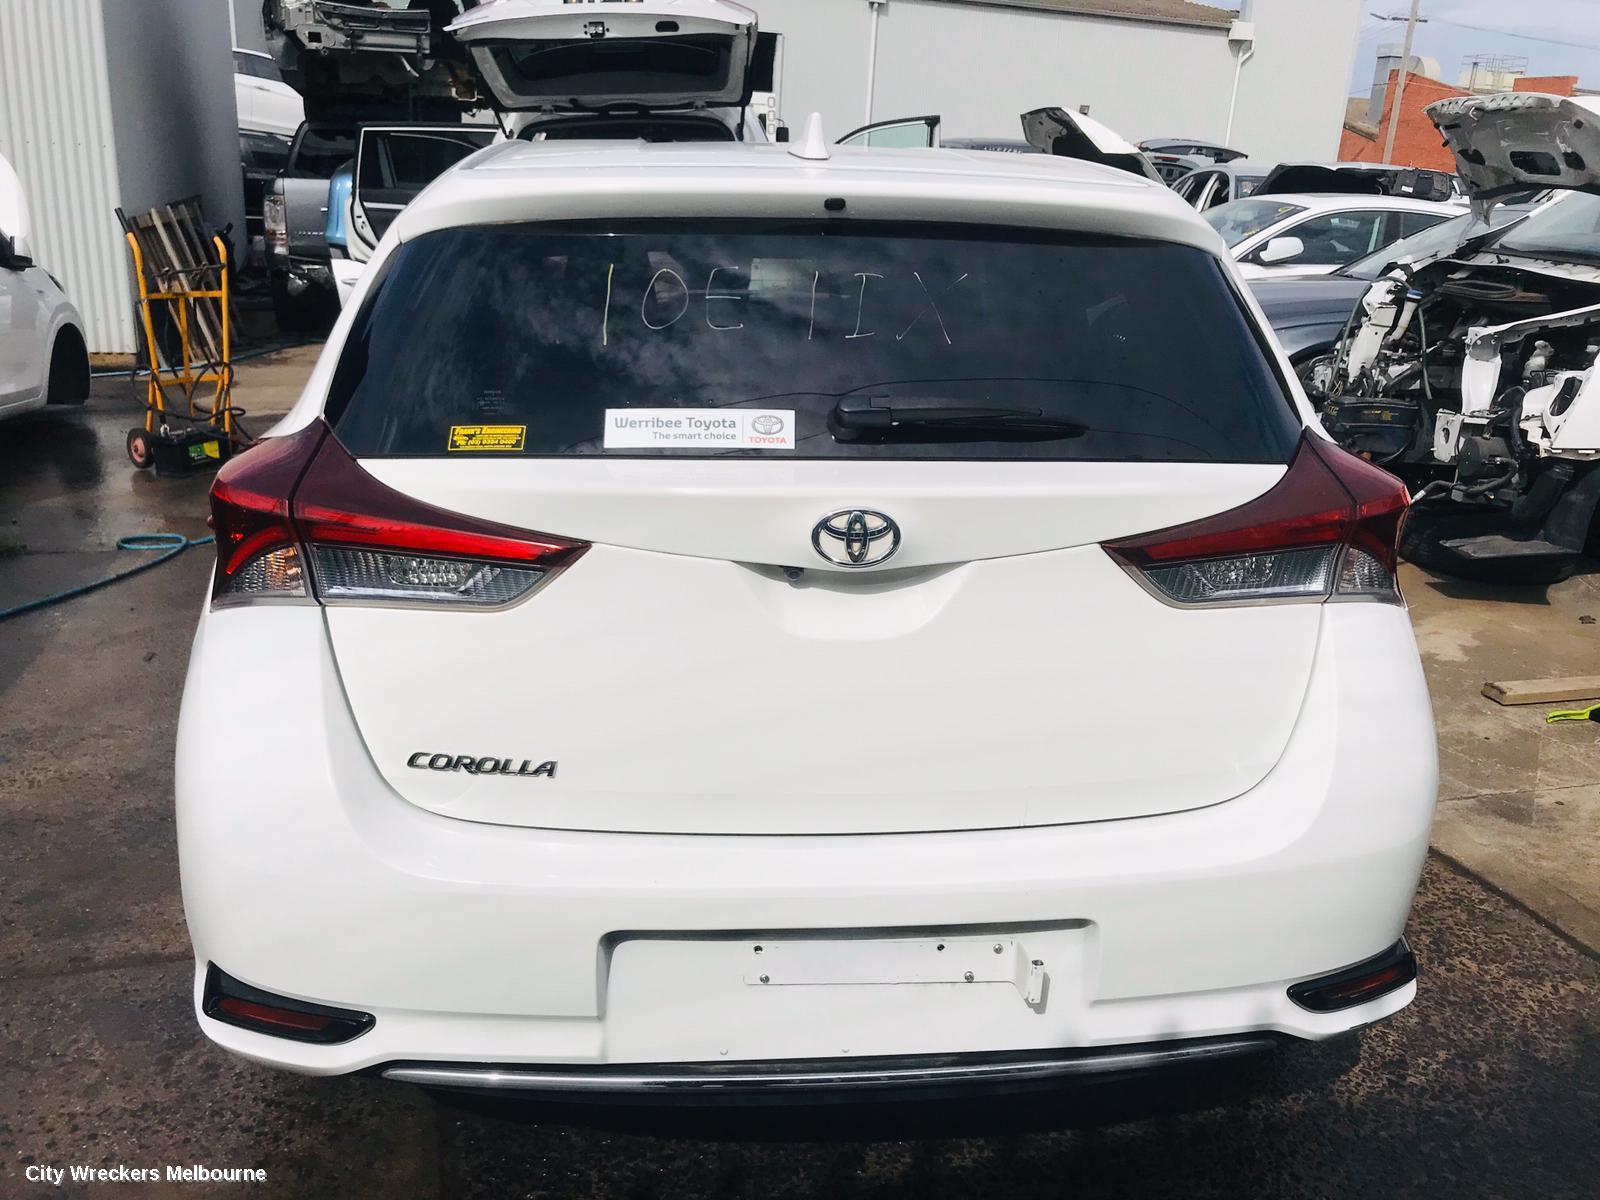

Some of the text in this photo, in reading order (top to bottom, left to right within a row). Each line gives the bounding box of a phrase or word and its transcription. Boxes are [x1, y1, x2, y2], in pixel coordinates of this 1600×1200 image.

[614, 416, 737, 432] Werribee Toyota
[653, 432, 737, 440] The smart choice
[407, 752, 558, 778] COROLLA
